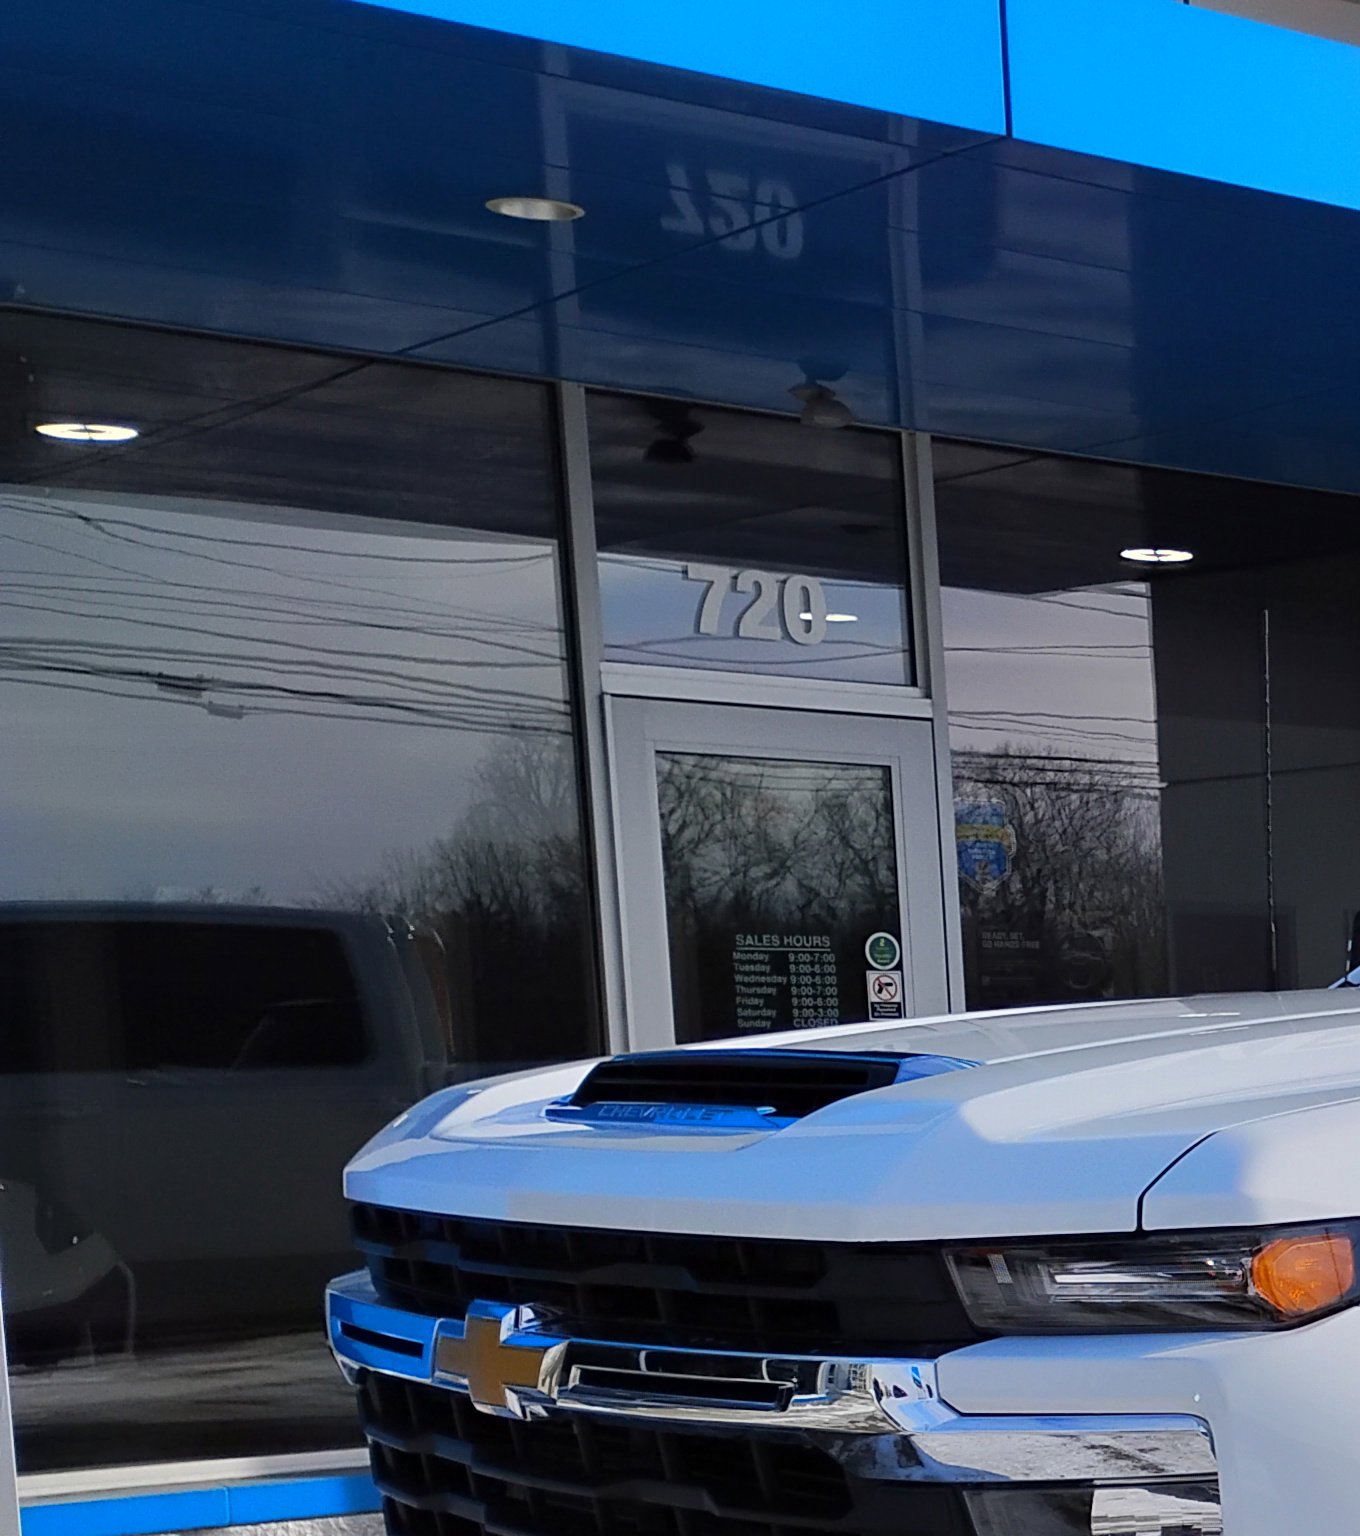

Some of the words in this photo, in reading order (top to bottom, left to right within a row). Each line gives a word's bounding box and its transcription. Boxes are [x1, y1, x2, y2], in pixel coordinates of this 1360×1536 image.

[684, 562, 828, 646] 720
[736, 934, 780, 946] SALES
[784, 935, 831, 947] HOURS
[732, 951, 769, 962] Monday
[788, 953, 836, 962] 9:00-7:00
[733, 963, 771, 973] Tuesday
[734, 974, 787, 985] Wednesday
[735, 985, 776, 996] Thursday
[791, 986, 838, 995] 9:00-7:00
[736, 996, 764, 1007] Friday
[737, 1007, 776, 1018] Saturday
[792, 1008, 839, 1018] 9:00-3:00
[737, 1018, 771, 1029] Sunday
[793, 1018, 839, 1028] CLOSED
[597, 1104, 735, 1122] CHEVROLET
